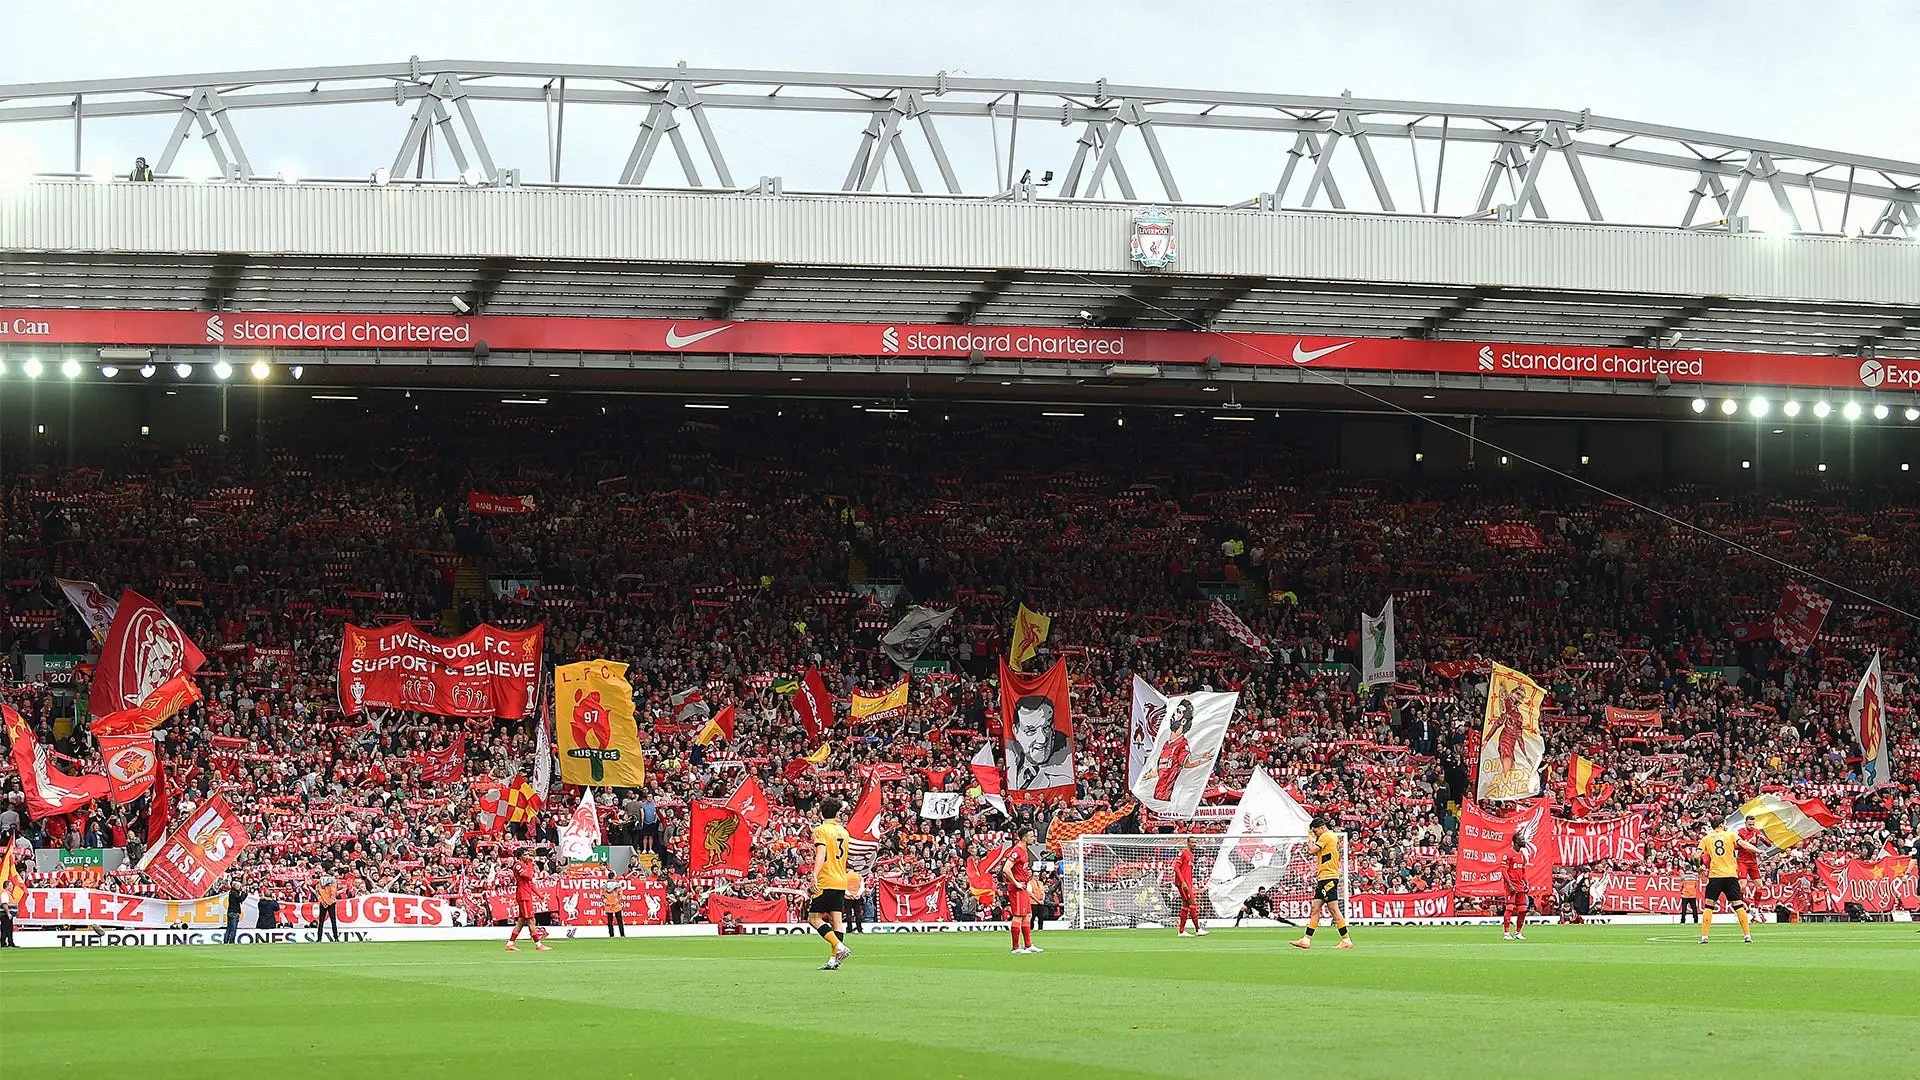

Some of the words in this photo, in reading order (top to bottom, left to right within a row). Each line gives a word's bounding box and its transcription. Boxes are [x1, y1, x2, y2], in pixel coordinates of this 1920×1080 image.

[13, 318, 49, 335] Can
[233, 320, 346, 341] standard
[351, 321, 470, 342] chartered
[907, 331, 1009, 352] standard
[1016, 333, 1124, 355] chartered
[1501, 350, 1597, 371] standard
[1602, 355, 1703, 375] chartered
[379, 632, 480, 659] LIVERPOOL
[484, 636, 516, 656] F.C.
[350, 655, 438, 674] SUPPORT
[445, 666, 458, 676] &
[464, 659, 535, 678] BELIEVE
[51, 673, 72, 683] 207
[584, 710, 599, 723] 97
[1200, 808, 1217, 816] WALK
[1481, 829, 1504, 842] EARTH
[836, 838, 845, 859] 3
[1557, 836, 1594, 866] WIN
[1714, 839, 1725, 857] 8
[1321, 888, 1327, 897] 9
[1607, 876, 1637, 890] WE
[1645, 877, 1680, 892] ARE
[895, 893, 913, 917] H
[1371, 901, 1406, 918] LAW
[1414, 898, 1448, 916] NOW
[1608, 895, 1644, 911] THE
[1649, 896, 1721, 913] FAMUS
[57, 935, 101, 947] THE
[107, 933, 203, 947] ROLLING
[210, 932, 297, 945] SONES
